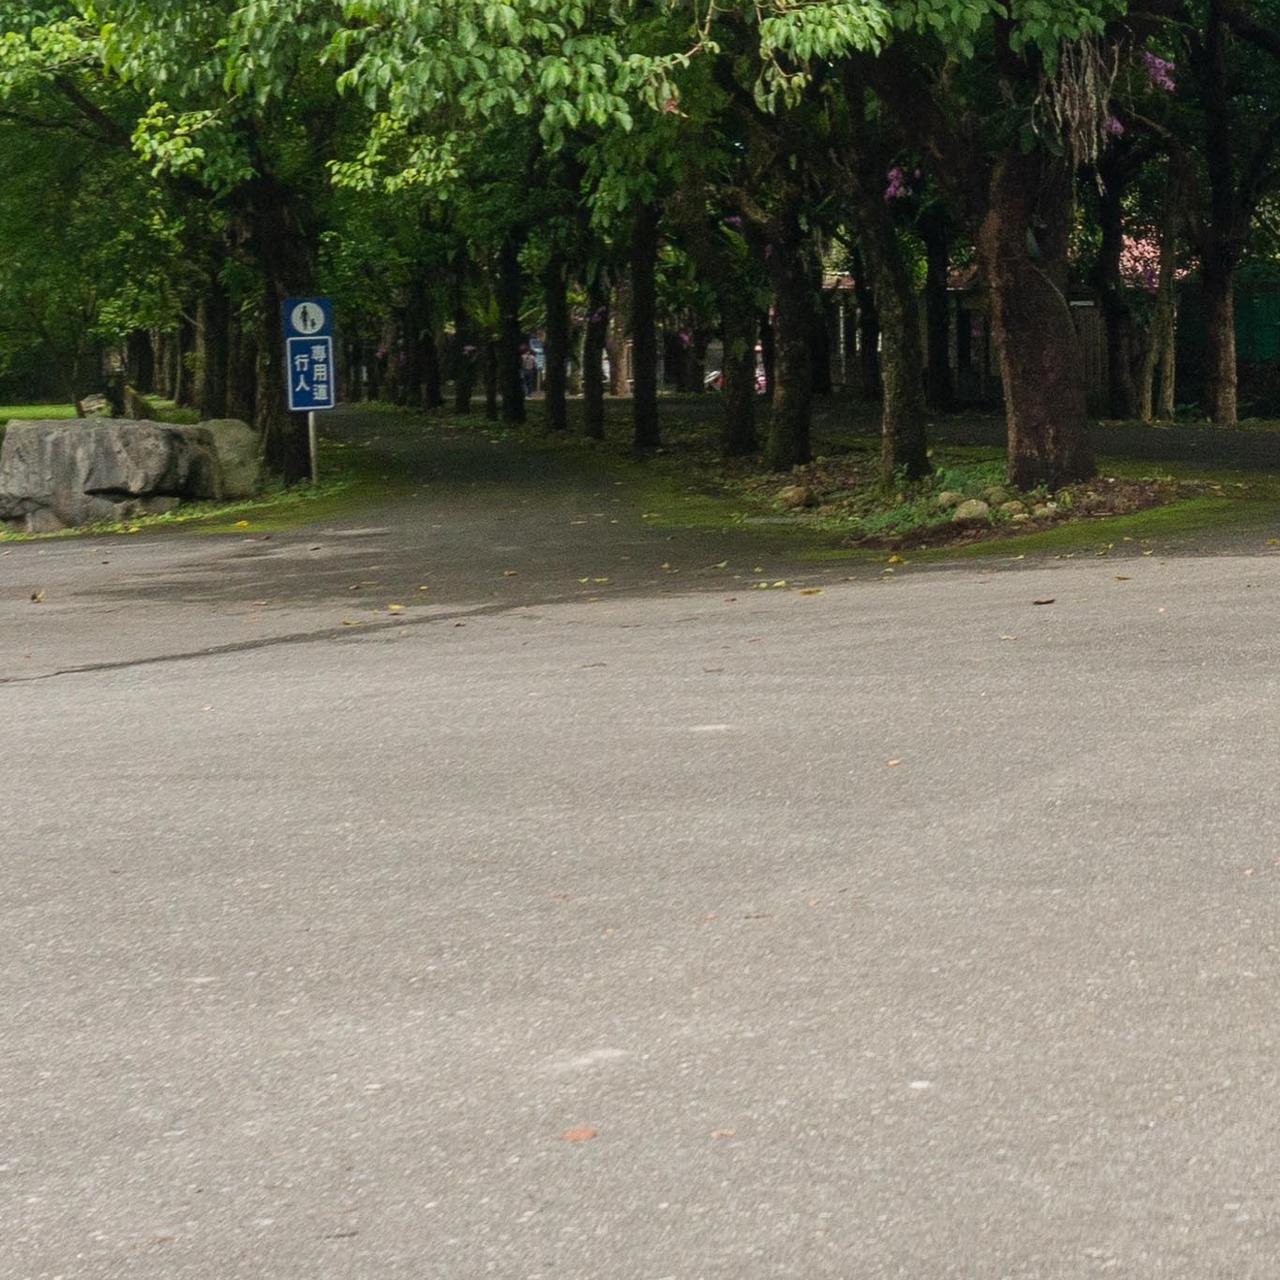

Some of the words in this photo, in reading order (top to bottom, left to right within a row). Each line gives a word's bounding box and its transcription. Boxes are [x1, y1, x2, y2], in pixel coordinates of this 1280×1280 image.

[294, 355, 310, 391] 行人
[311, 345, 328, 400] 專用道
